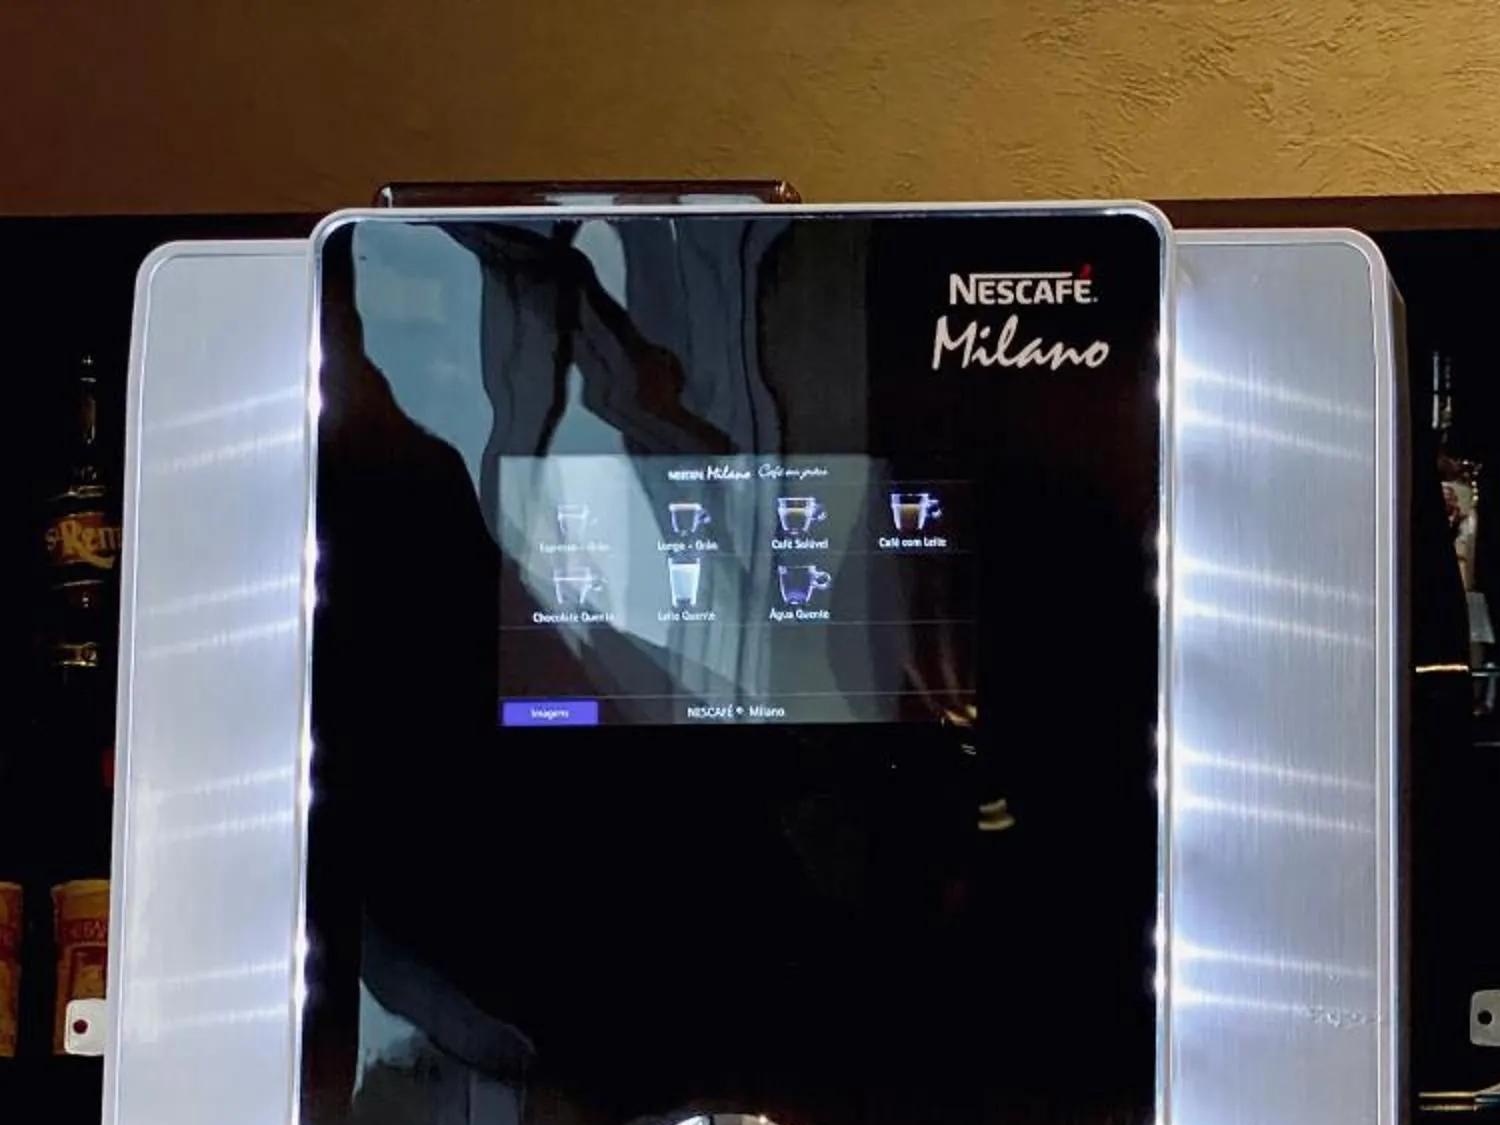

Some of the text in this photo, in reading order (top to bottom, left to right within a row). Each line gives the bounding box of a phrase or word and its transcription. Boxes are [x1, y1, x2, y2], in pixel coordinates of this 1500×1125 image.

[932, 314, 1110, 371] Milano
[707, 465, 750, 480] Milano
[879, 537, 899, 548] Café
[749, 705, 785, 718] Milano
